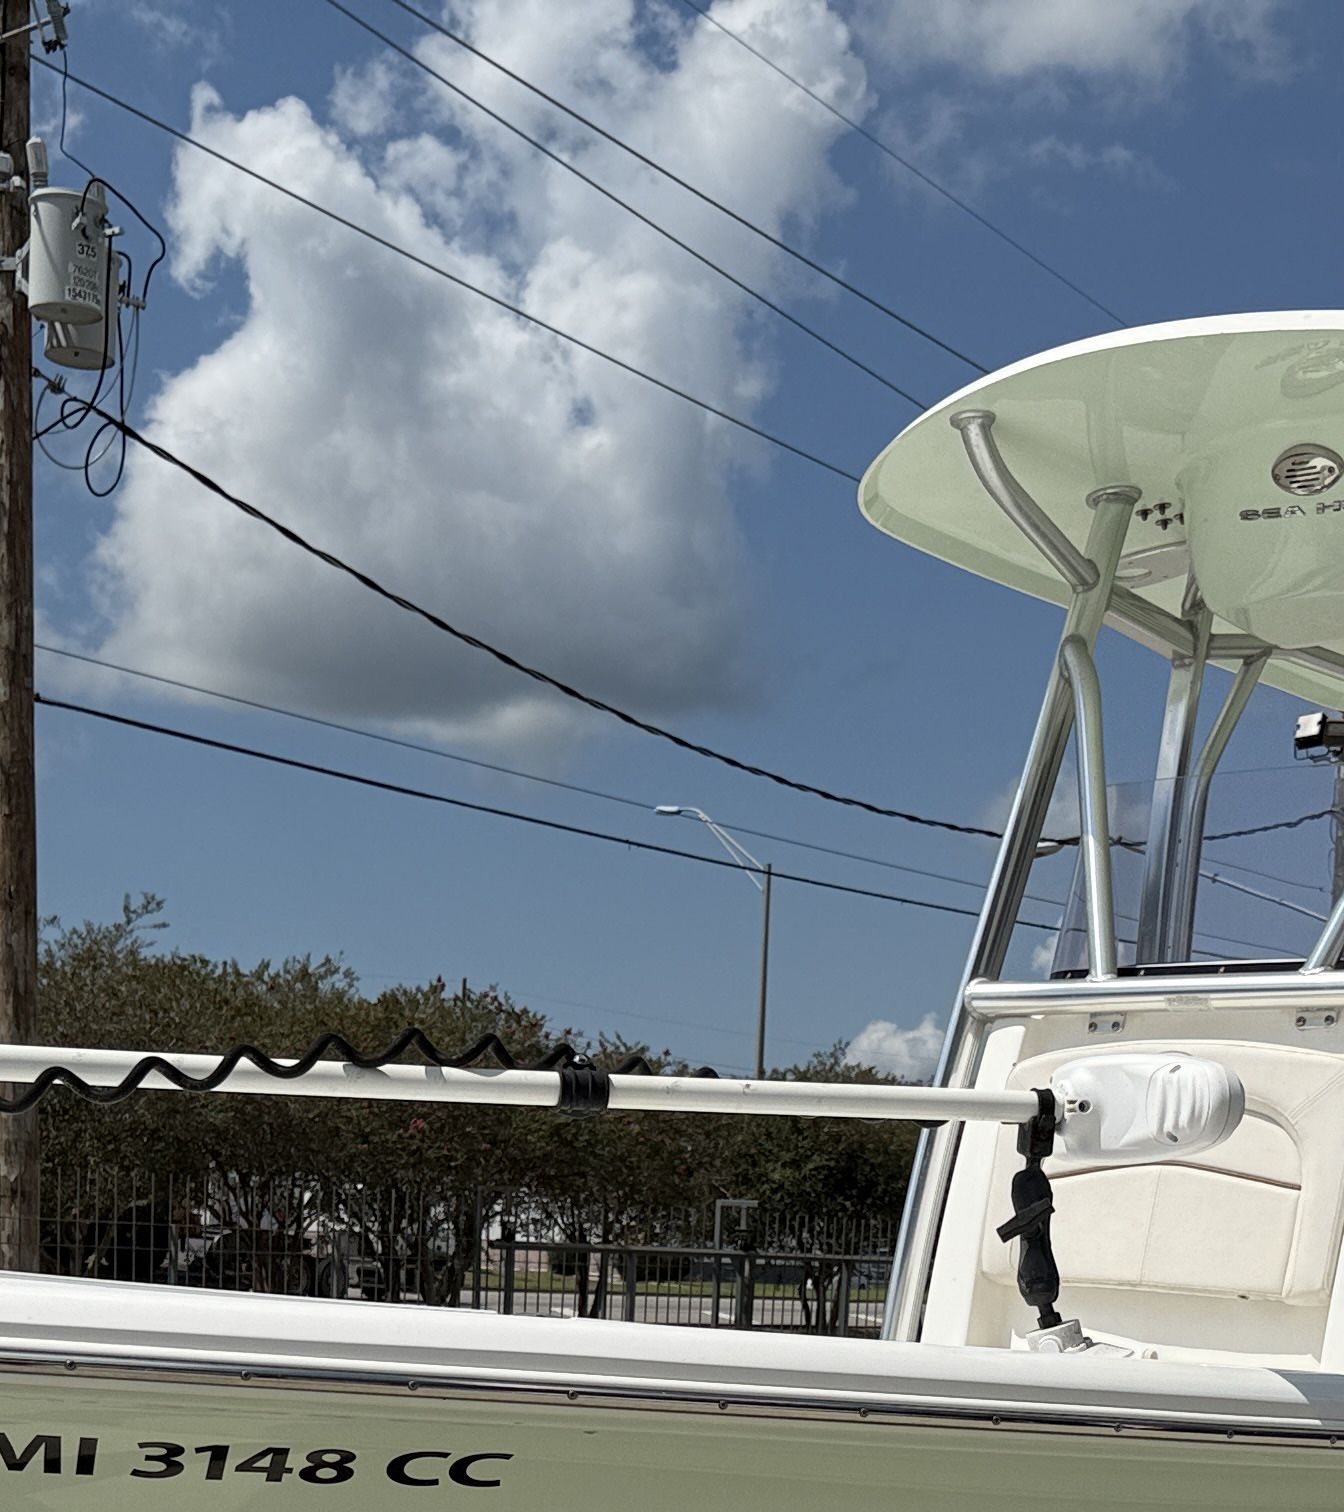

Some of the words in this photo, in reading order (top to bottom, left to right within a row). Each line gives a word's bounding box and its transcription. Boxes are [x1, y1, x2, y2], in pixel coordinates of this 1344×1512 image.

[1239, 505, 1306, 521] SEA
[130, 1441, 358, 1485] 3148
[385, 1450, 515, 1487] CC
